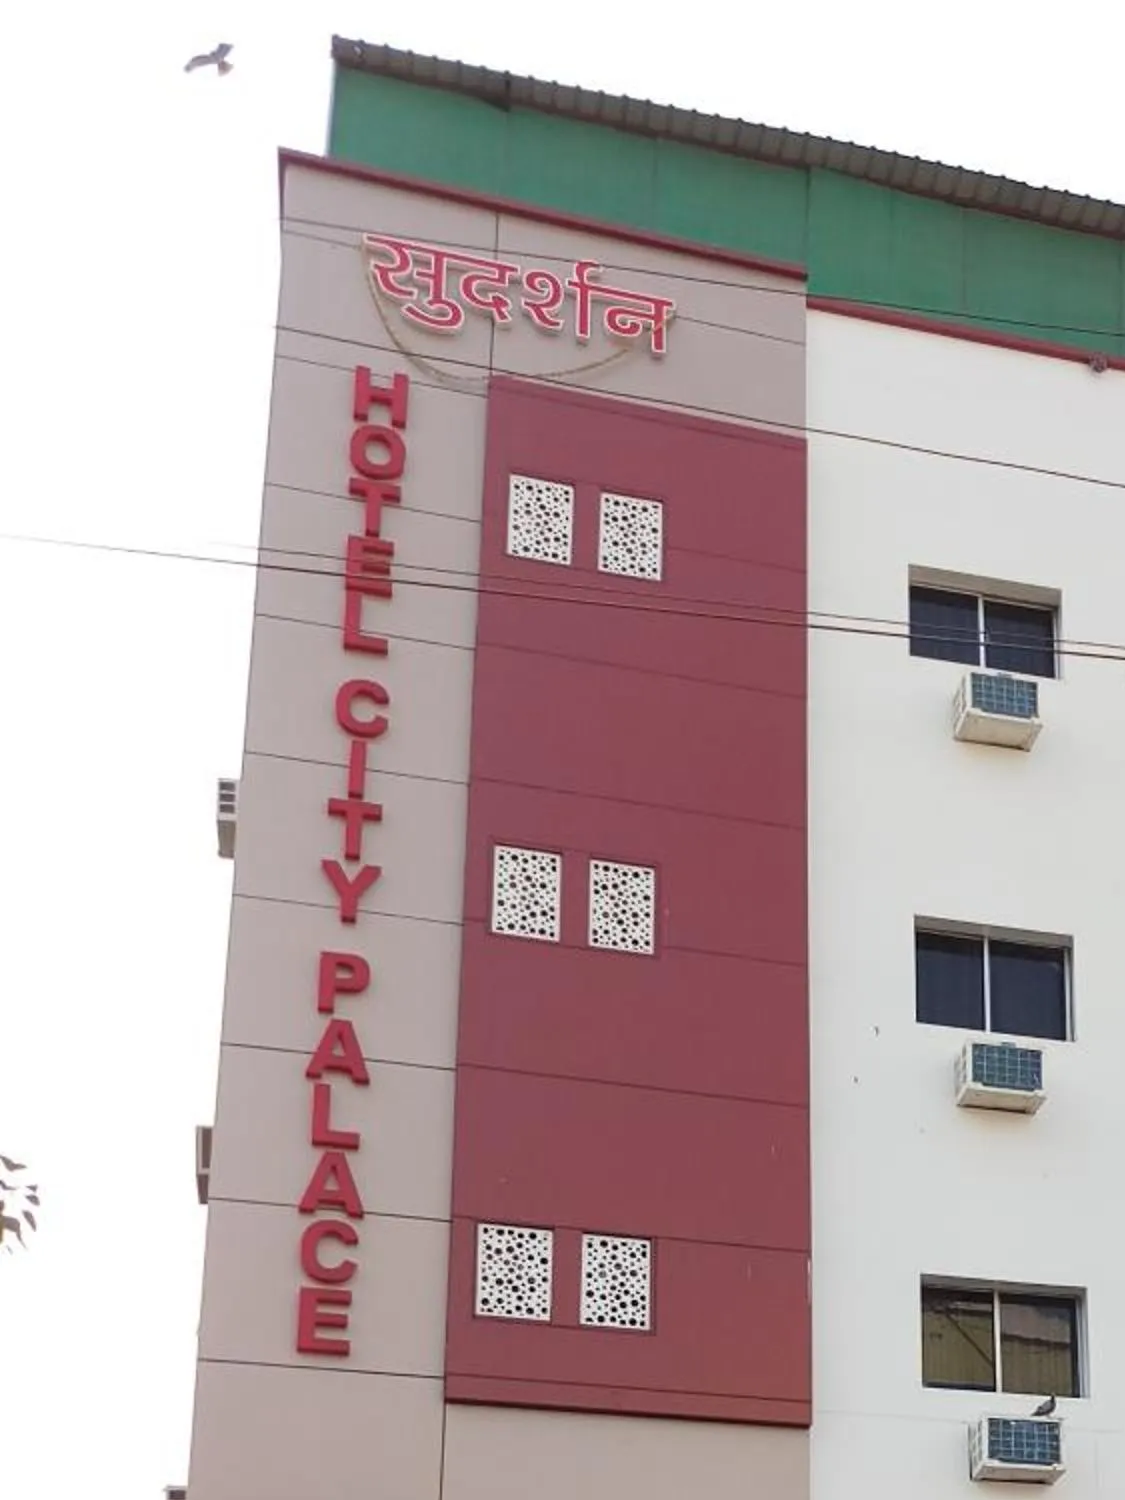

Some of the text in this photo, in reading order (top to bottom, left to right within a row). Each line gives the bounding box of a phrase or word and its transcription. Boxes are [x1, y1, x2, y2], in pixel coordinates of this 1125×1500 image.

[362, 232, 676, 361] सुदर्शन
[296, 365, 409, 1356] HOTEL CITY PALACE
